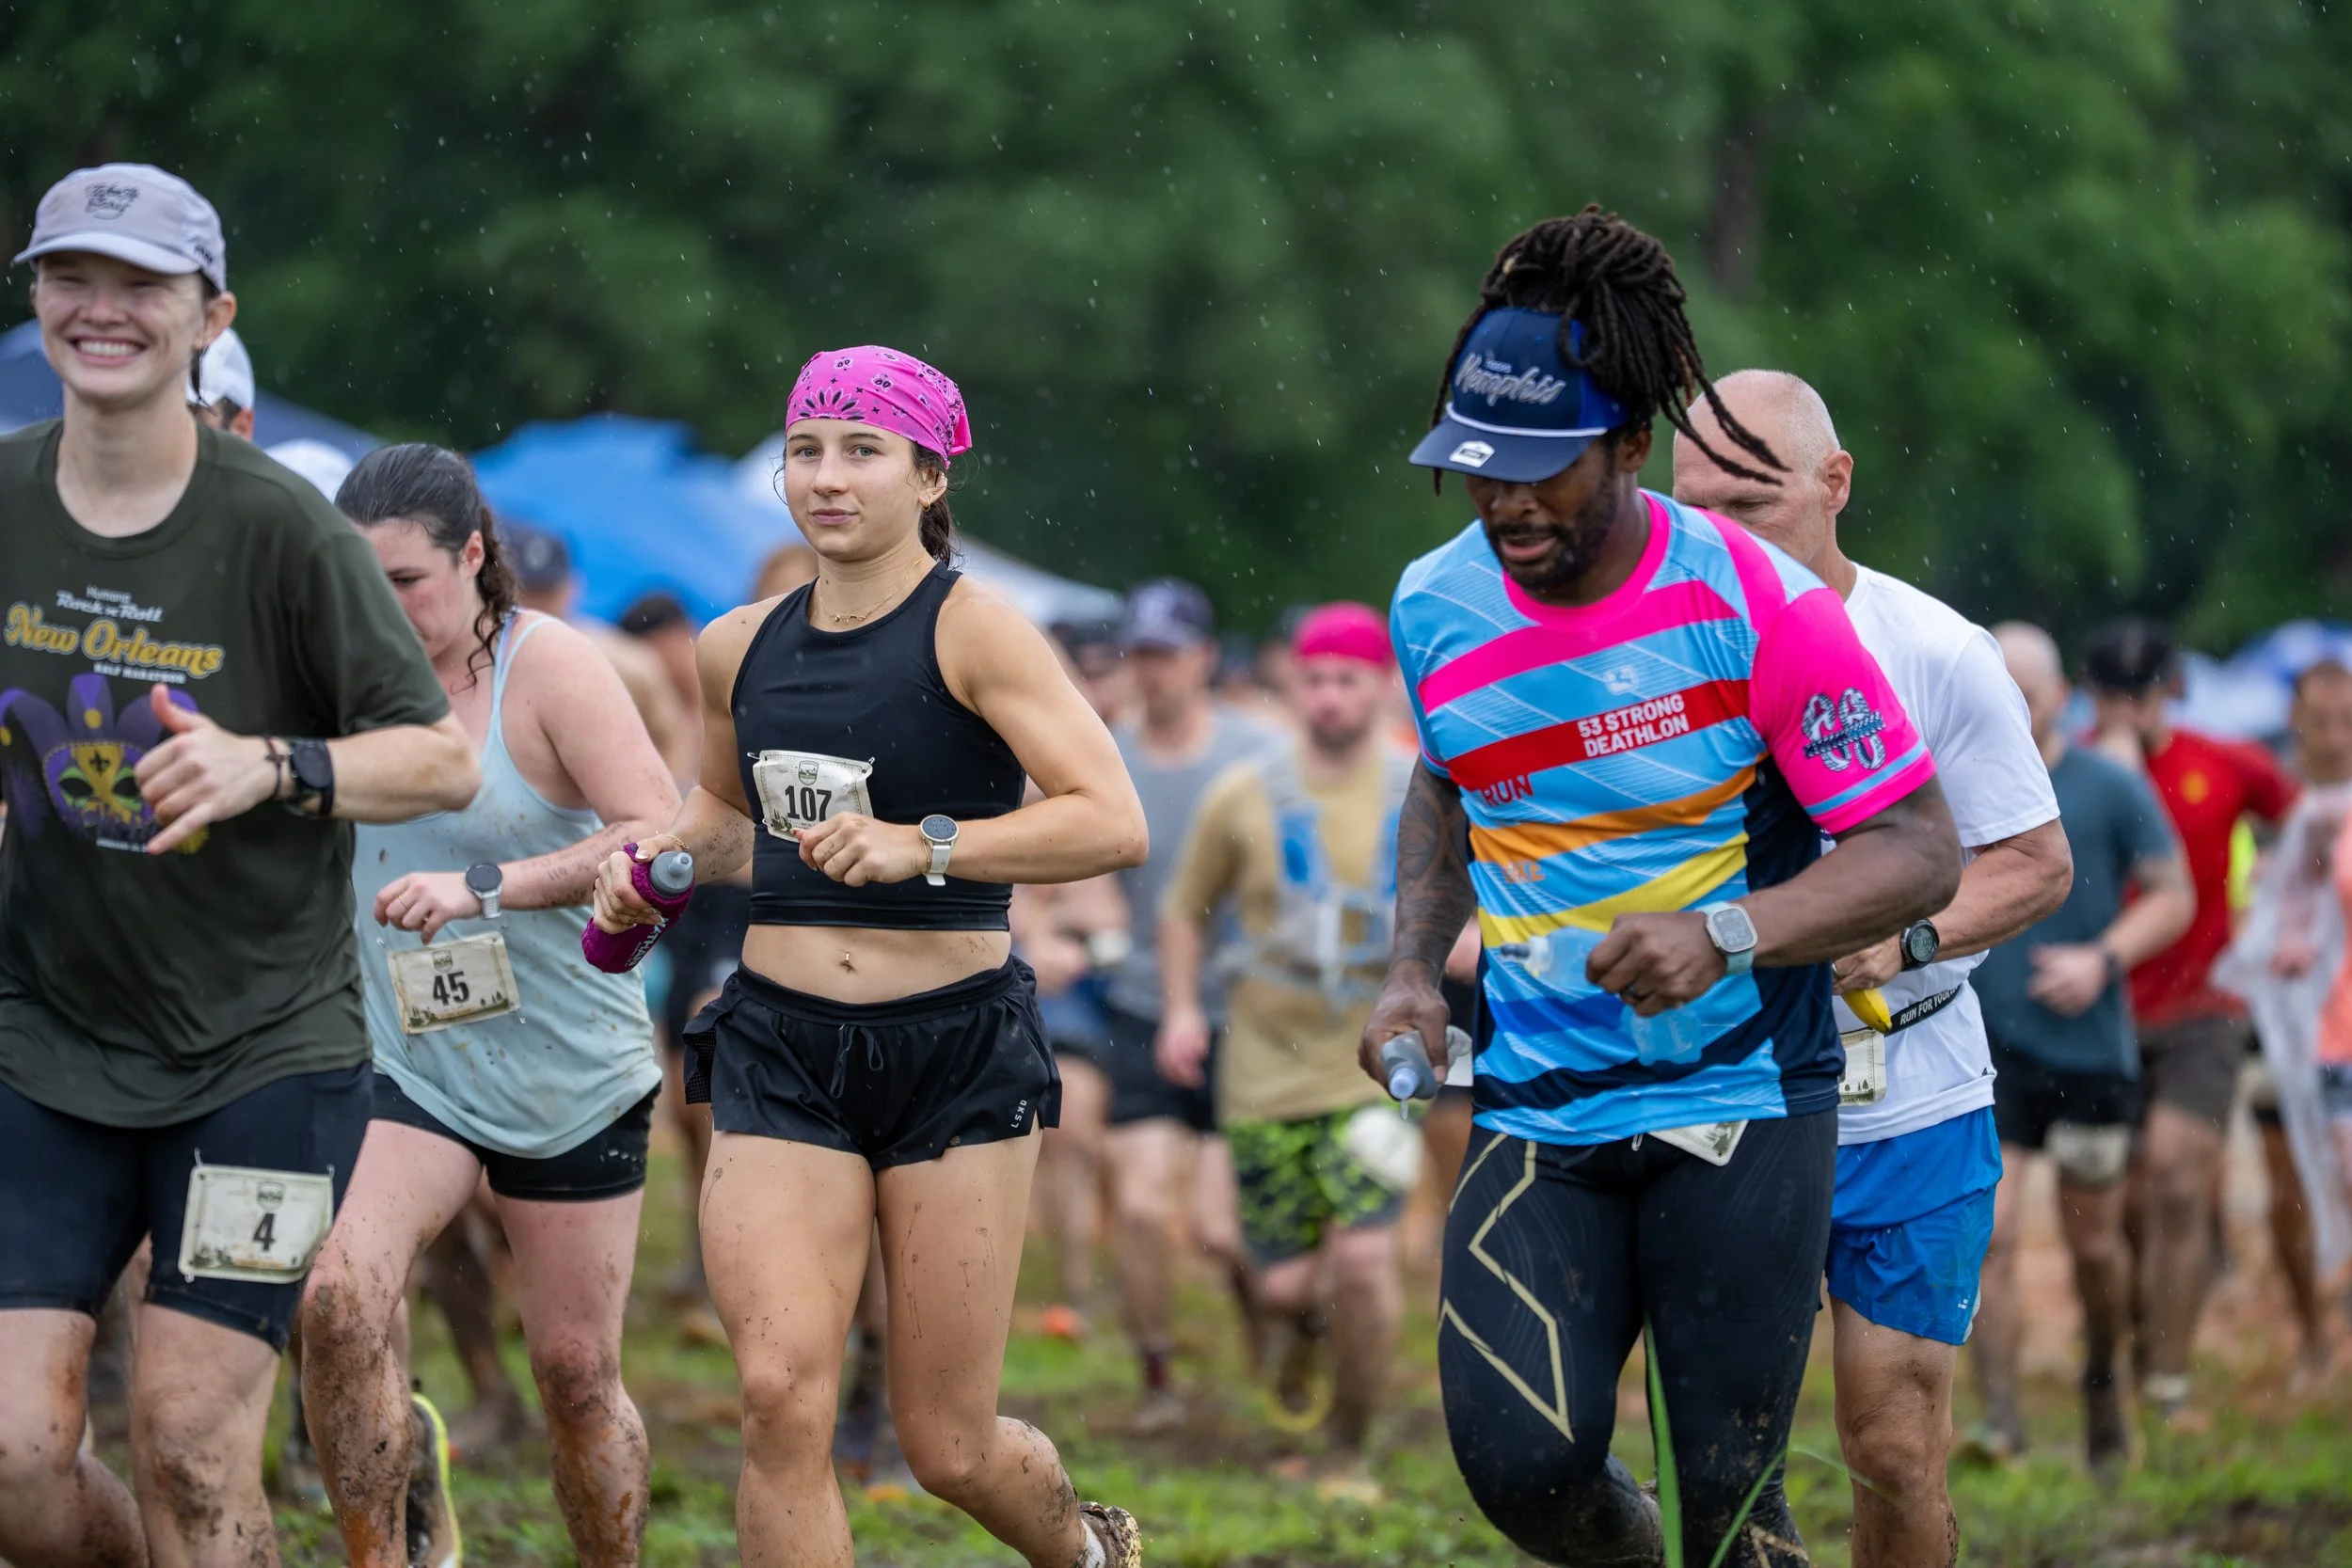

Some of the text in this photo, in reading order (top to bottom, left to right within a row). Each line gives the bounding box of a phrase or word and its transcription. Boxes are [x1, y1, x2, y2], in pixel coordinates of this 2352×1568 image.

[5, 604, 226, 678] New Orleans
[1577, 693, 1685, 738] 53 STRONG
[1583, 713, 1690, 758] DEATHLON
[785, 785, 833, 822] 107
[1482, 771, 1534, 806] RUN
[432, 971, 469, 1006] 45
[1900, 1007, 1916, 1026] RUN
[1917, 999, 1933, 1017] FOR
[1010, 1099, 1027, 1129] LSKD
[252, 1212, 277, 1252] 4
